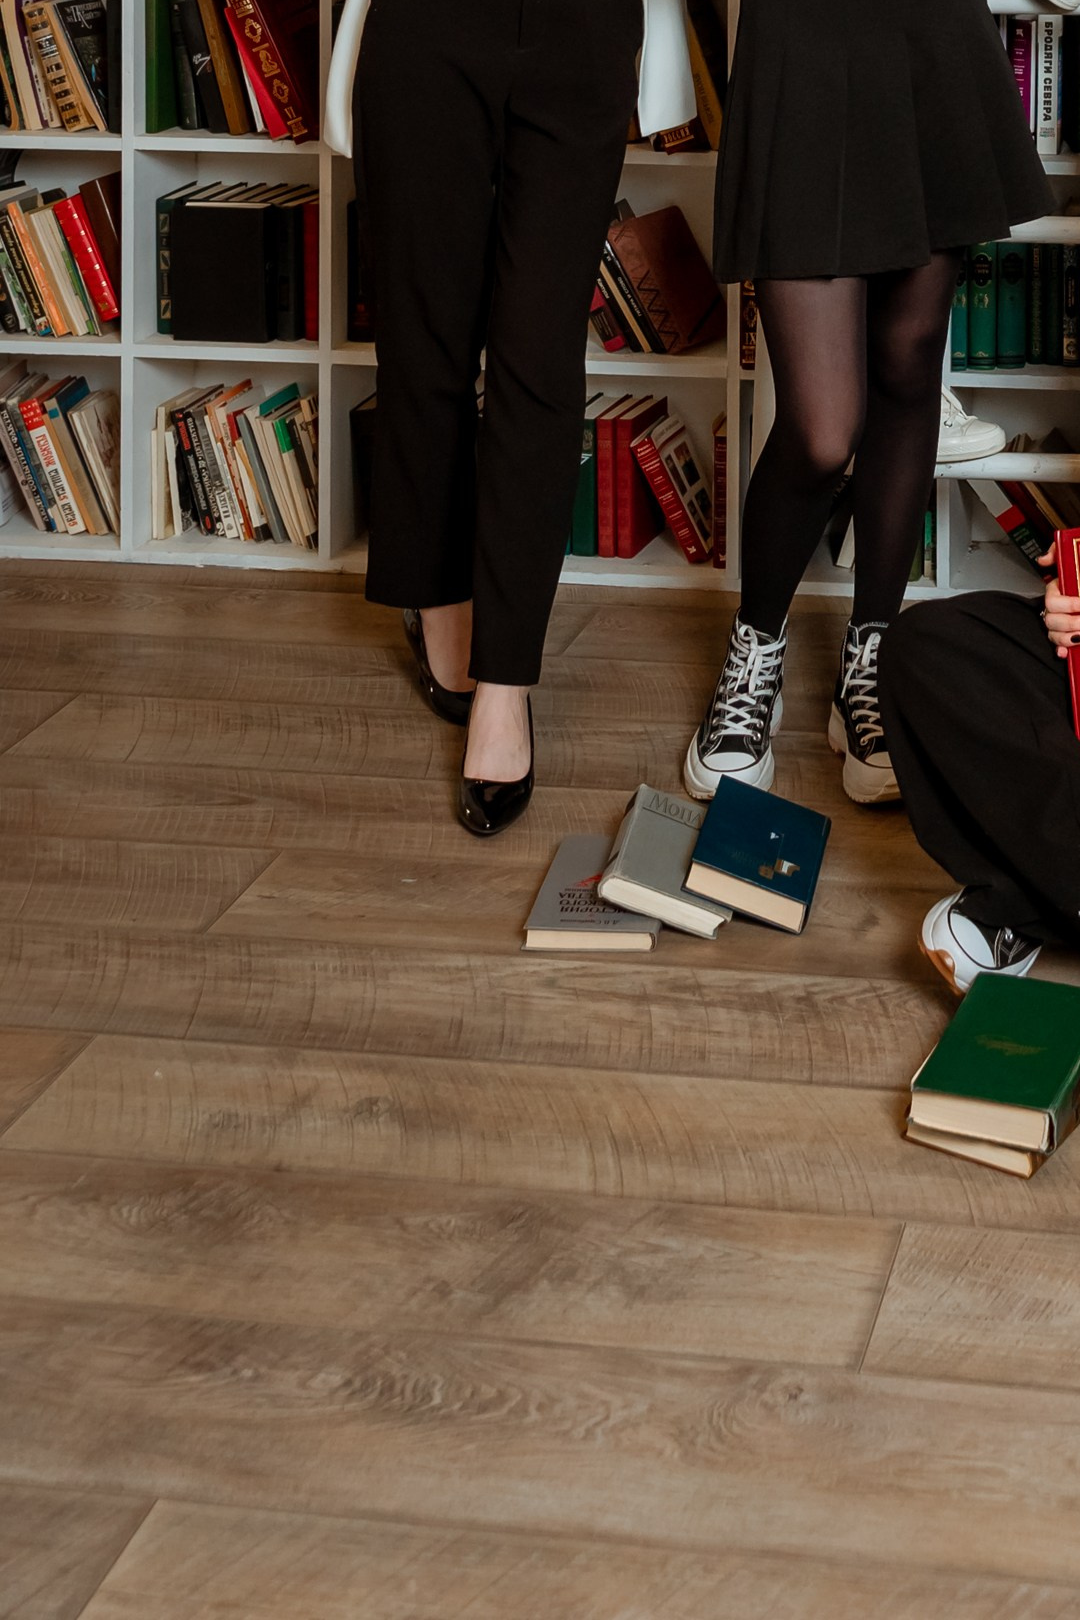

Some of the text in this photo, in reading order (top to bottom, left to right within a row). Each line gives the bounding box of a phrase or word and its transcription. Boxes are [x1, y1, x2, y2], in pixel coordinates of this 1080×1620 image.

[1042, 21, 1054, 121] БРОДЯГИ СЕВЕРА
[284, 107, 297, 120] VI
[0, 409, 18, 444] ФАКТЫ
[12, 445, 38, 492] СОБЫТИЯ
[46, 466, 68, 501] СТАРИНА
[186, 415, 220, 518] ФАНТАСТИКА ДЕТЕКТИВ
[215, 521, 225, 538] 2
